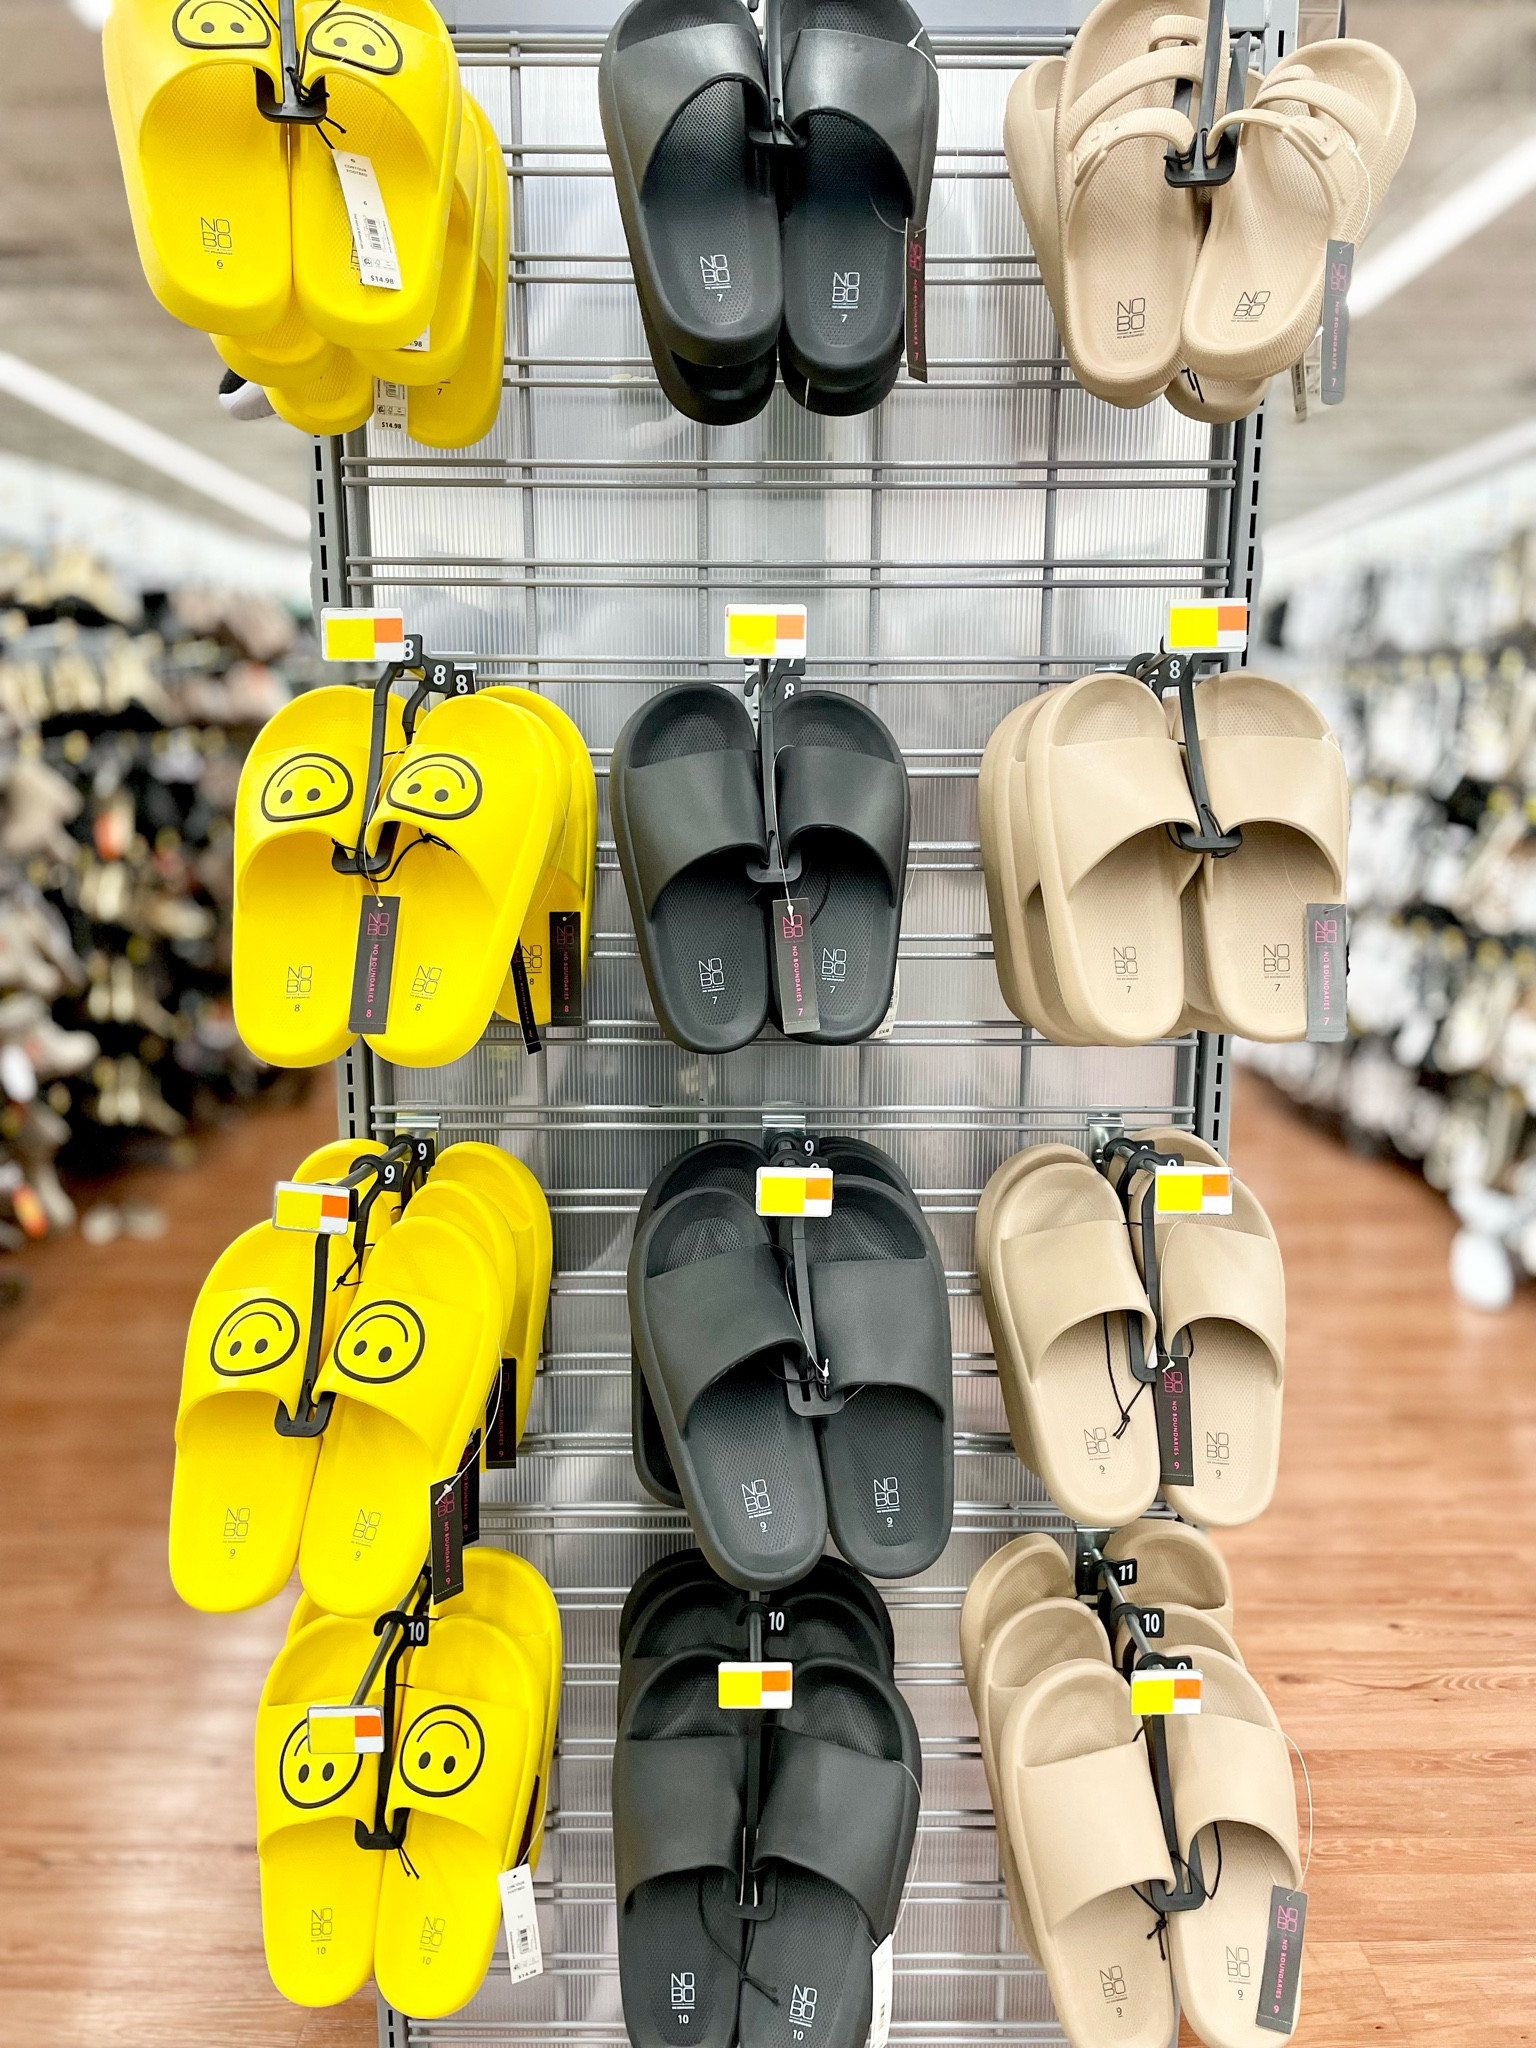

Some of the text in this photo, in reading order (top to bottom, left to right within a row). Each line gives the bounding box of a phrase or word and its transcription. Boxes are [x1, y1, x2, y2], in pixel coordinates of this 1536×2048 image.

[201, 217, 230, 233] NO
[202, 232, 232, 248] BO
[700, 255, 727, 269] NO
[371, 275, 394, 284] $14.98
[702, 269, 731, 283] BO
[833, 272, 860, 287] NO
[717, 294, 723, 302] 7
[832, 287, 859, 302] BO
[1239, 291, 1271, 304] NO
[1117, 298, 1145, 315] NO
[1233, 304, 1266, 317] BO
[841, 314, 847, 322] 7
[1117, 314, 1145, 332] BO
[1331, 378, 1336, 387] 7
[404, 639, 414, 660] 8
[433, 665, 446, 685] 8
[1170, 660, 1180, 679] 8
[456, 674, 468, 694] 8
[369, 913, 389, 925] NO
[783, 915, 802, 927] NO
[1315, 920, 1337, 932] NO
[367, 924, 388, 936] BO
[783, 926, 803, 938] BO
[1315, 931, 1337, 943] BO
[823, 948, 847, 962] NO
[1113, 946, 1136, 960] NO
[1263, 944, 1290, 958] NO
[699, 958, 722, 972] NO
[822, 961, 846, 975] BO
[1115, 960, 1138, 974] BO
[1264, 957, 1290, 972] BO
[288, 966, 312, 979] NO
[368, 944, 379, 1003] NO BOUNDARIES
[416, 965, 442, 981] NO
[701, 971, 724, 987] BO
[792, 946, 802, 1002] NO BOUNDARIES
[287, 980, 311, 993] BO
[412, 978, 438, 994] BO
[830, 986, 836, 994] 7
[1275, 984, 1280, 992] 7
[294, 1004, 300, 1012] 8
[366, 1009, 372, 1017] 8
[798, 1008, 804, 1016] 7
[1324, 1017, 1330, 1025] 7
[418, 1143, 427, 1160] 9
[805, 1140, 814, 1156] 9
[384, 1165, 395, 1184] 9
[1164, 1371, 1182, 1383] NO
[1165, 1382, 1183, 1393] BO
[1172, 1401, 1177, 1410] NO
[1084, 1427, 1107, 1441] NO
[1207, 1432, 1229, 1445] NO
[1086, 1441, 1109, 1455] BO
[1207, 1445, 1229, 1459] BO
[1100, 1465, 1105, 1473] 9
[742, 1479, 767, 1498] NO
[874, 1477, 898, 1492] NO
[745, 1493, 770, 1512] BO
[875, 1490, 900, 1507] BO
[226, 1508, 250, 1522] NO
[357, 1509, 381, 1526] NO
[887, 1517, 893, 1525] 9
[224, 1522, 248, 1536] BO
[353, 1523, 377, 1541] BO
[760, 1522, 767, 1530] 9
[230, 1549, 236, 1557] 9
[355, 1551, 361, 1559] 9
[1119, 1564, 1133, 1580] 11
[769, 1612, 784, 1631] 10
[1143, 1613, 1160, 1633] 10
[409, 1622, 424, 1641] 10
[312, 1908, 332, 1922] NO
[1277, 1905, 1298, 1920] NO
[311, 1921, 332, 1936] BO
[424, 1917, 445, 1933] NO
[1277, 1917, 1297, 1932] BO
[420, 1930, 442, 1946] BO
[317, 1947, 326, 1955] 10
[1226, 1946, 1249, 1962] NO
[422, 1956, 431, 1965] 10
[1100, 1966, 1123, 1982] NO
[1227, 1961, 1250, 1978] BO
[1276, 1939, 1287, 1998] NO BOUNDARIES
[671, 1972, 694, 1987] NO
[672, 1987, 695, 2002] BO
[793, 1985, 817, 2004] NO
[1103, 1979, 1126, 1997] BO
[1238, 1990, 1243, 1998] 9
[790, 2000, 815, 2020] BO
[1117, 2007, 1122, 2015] 9
[1273, 2005, 1279, 2013] 9
[678, 2014, 689, 2024] 10
[793, 2030, 804, 2040] 10
